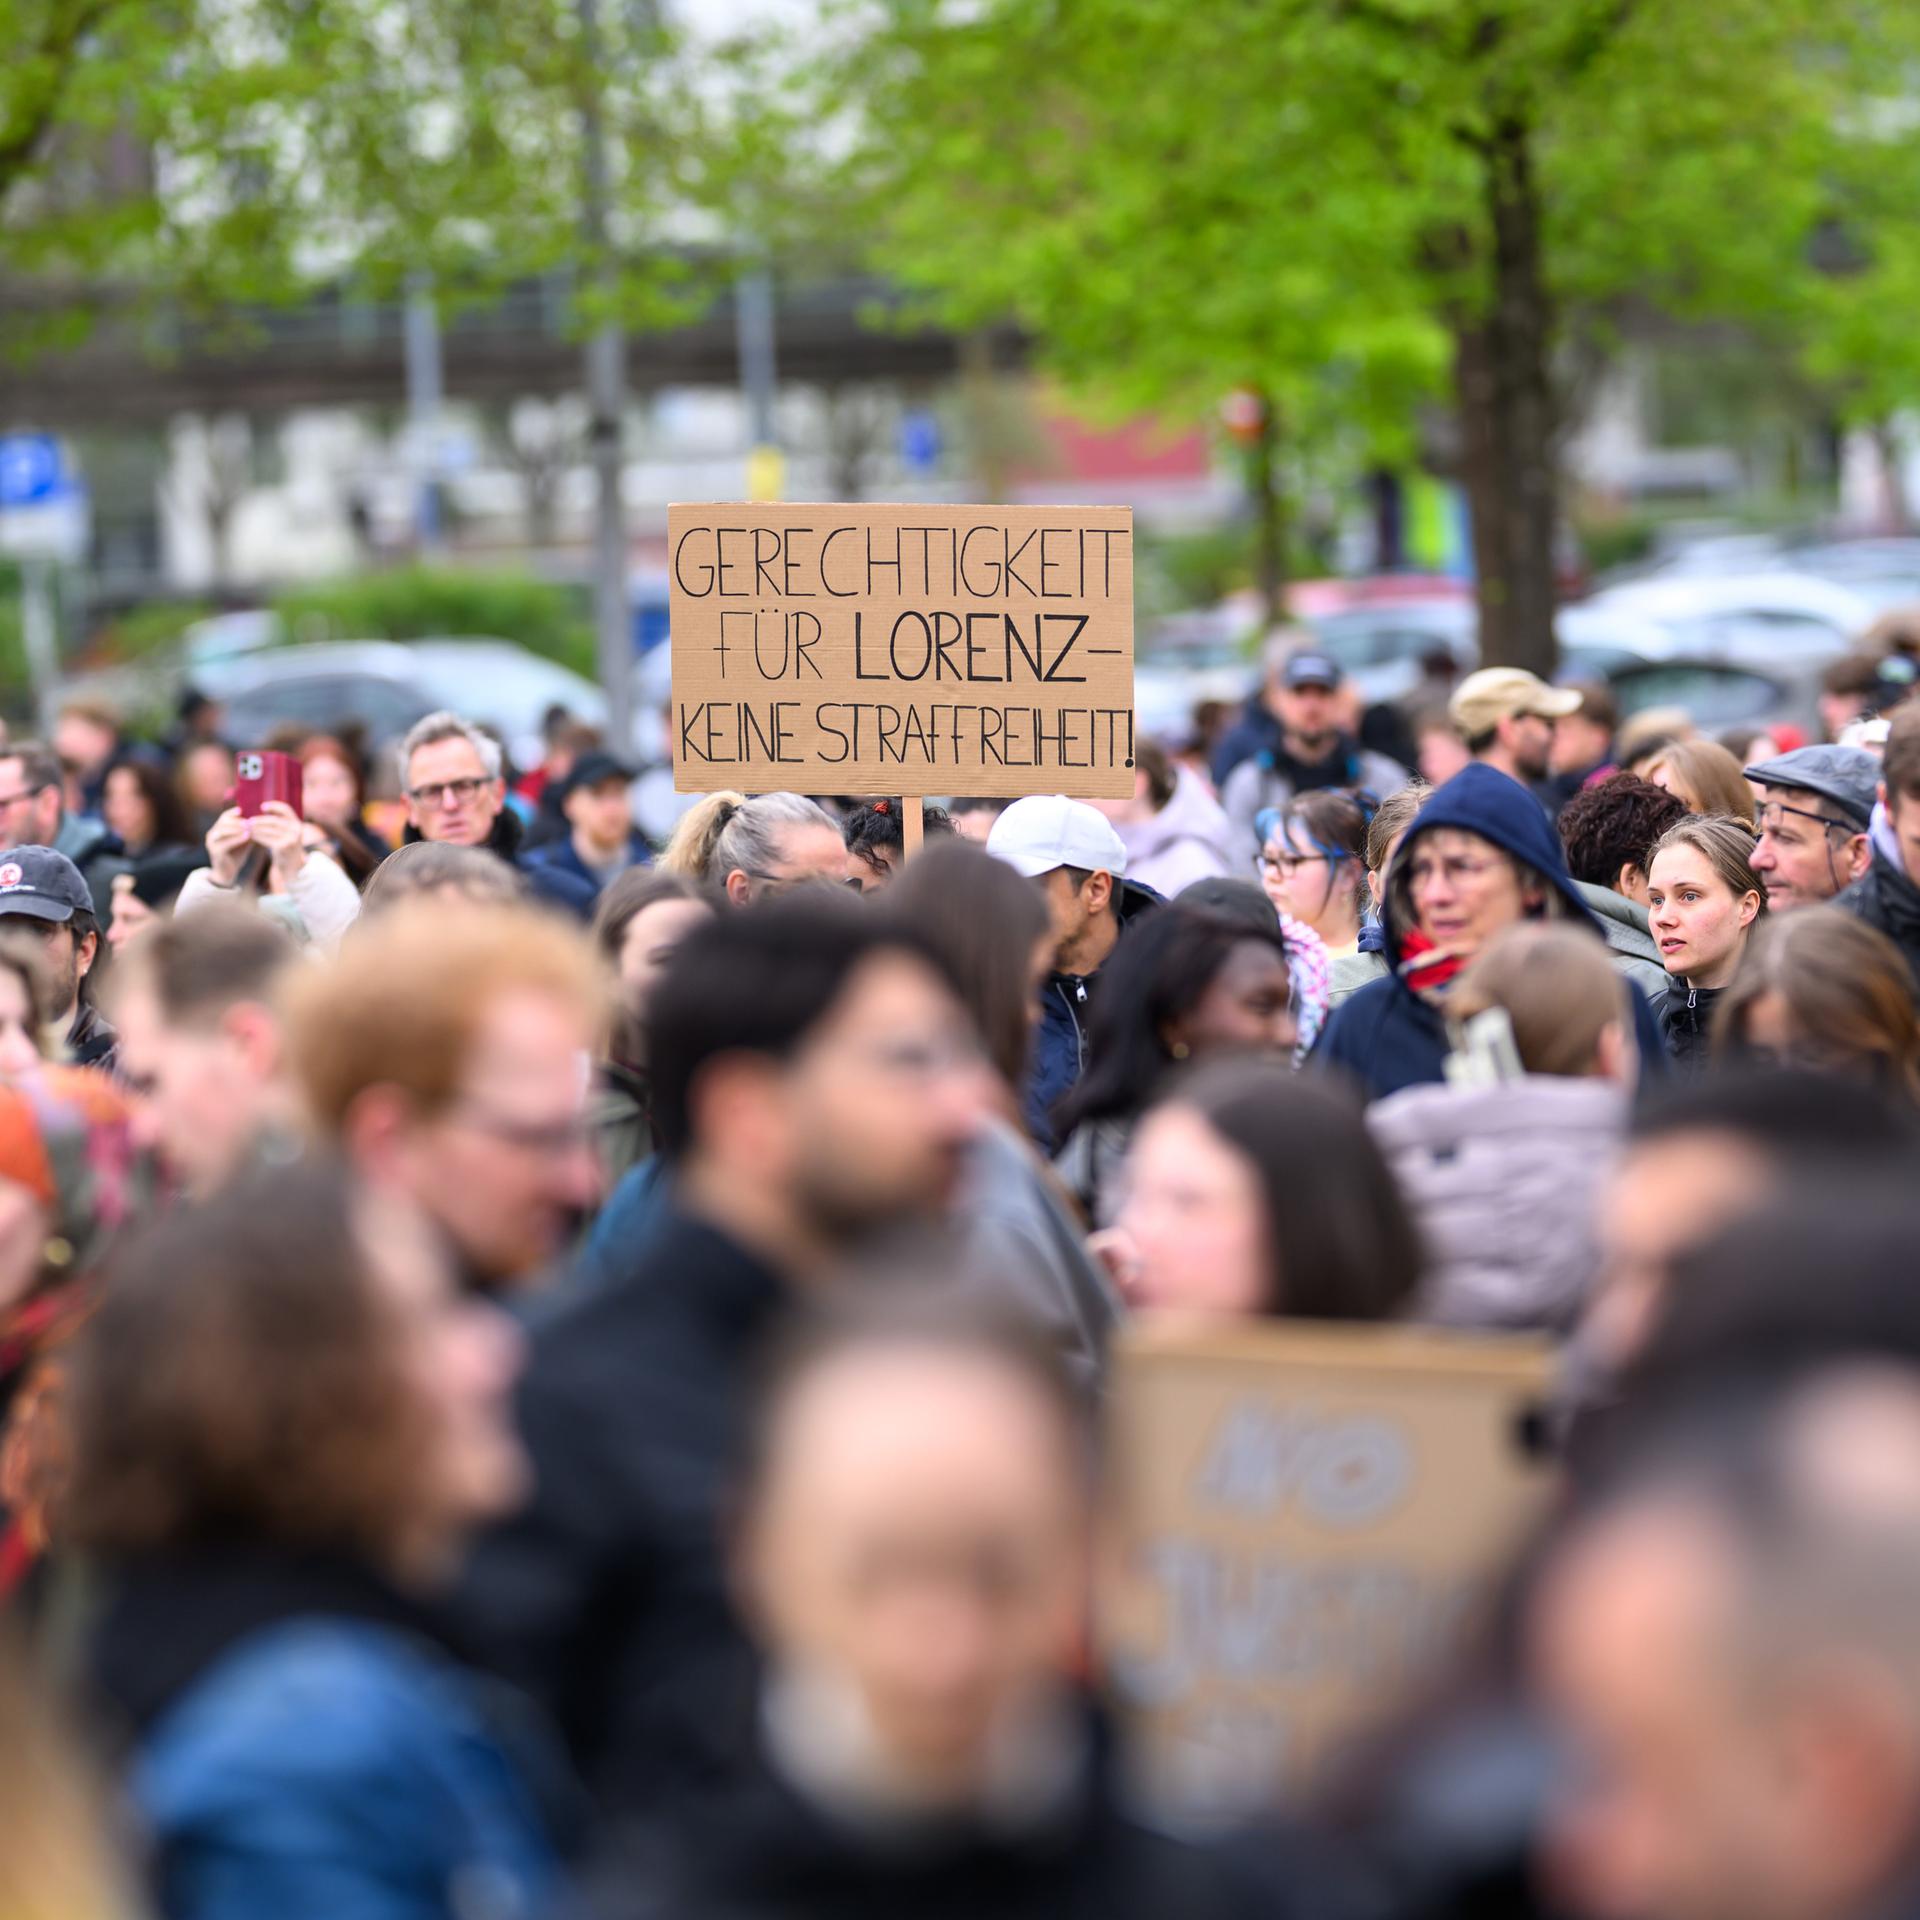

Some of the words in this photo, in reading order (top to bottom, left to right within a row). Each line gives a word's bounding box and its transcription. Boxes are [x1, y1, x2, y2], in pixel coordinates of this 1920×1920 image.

[676, 526, 1129, 597] GERECHTIGKEIT
[713, 608, 823, 680] FÜR
[681, 702, 804, 763] KEINE
[816, 703, 1135, 768] STRAFFREIHEIT!
